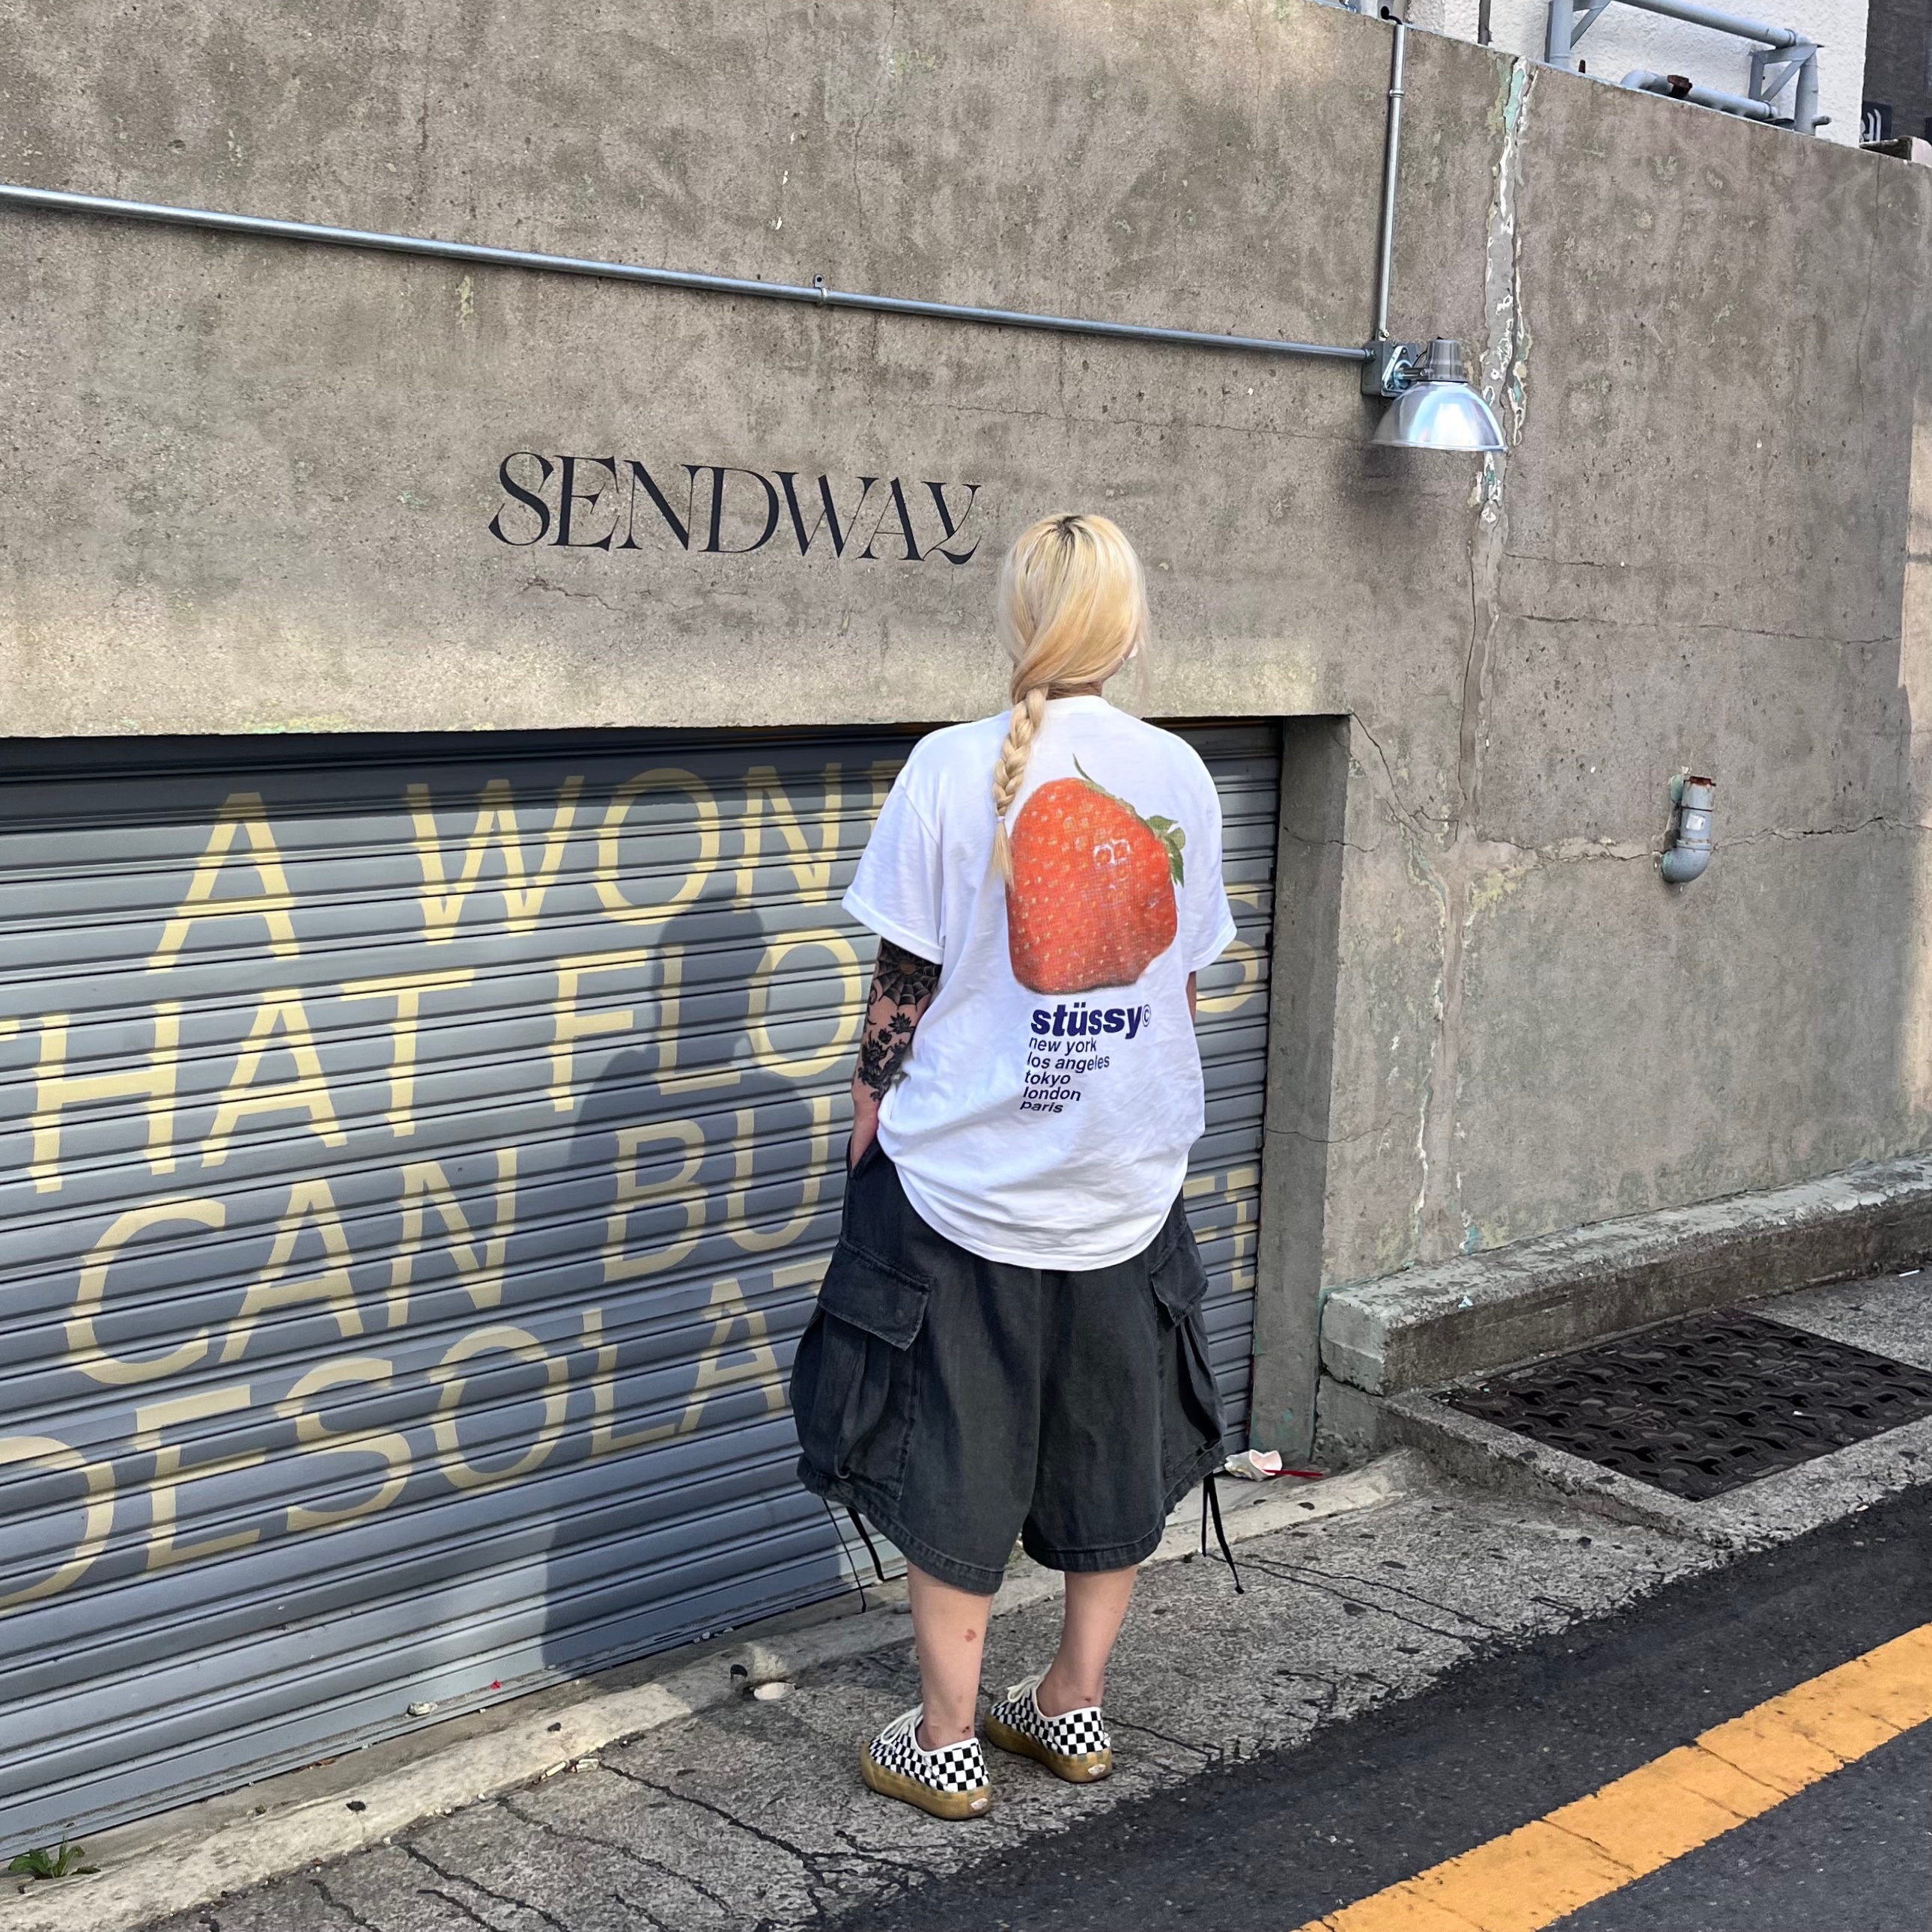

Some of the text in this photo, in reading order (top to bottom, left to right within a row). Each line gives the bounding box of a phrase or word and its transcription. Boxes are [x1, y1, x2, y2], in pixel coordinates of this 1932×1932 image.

[487, 451, 982, 565] SENDWAY
[147, 792, 300, 974] A
[1028, 1037, 1097, 1056] new york
[1027, 1051, 1110, 1073] los angeles
[0, 968, 475, 1194] HAT
[1024, 1070, 1071, 1087] tokyo
[1022, 1087, 1081, 1101] london
[1019, 1100, 1063, 1114] paris
[64, 1147, 517, 1385] CAN
